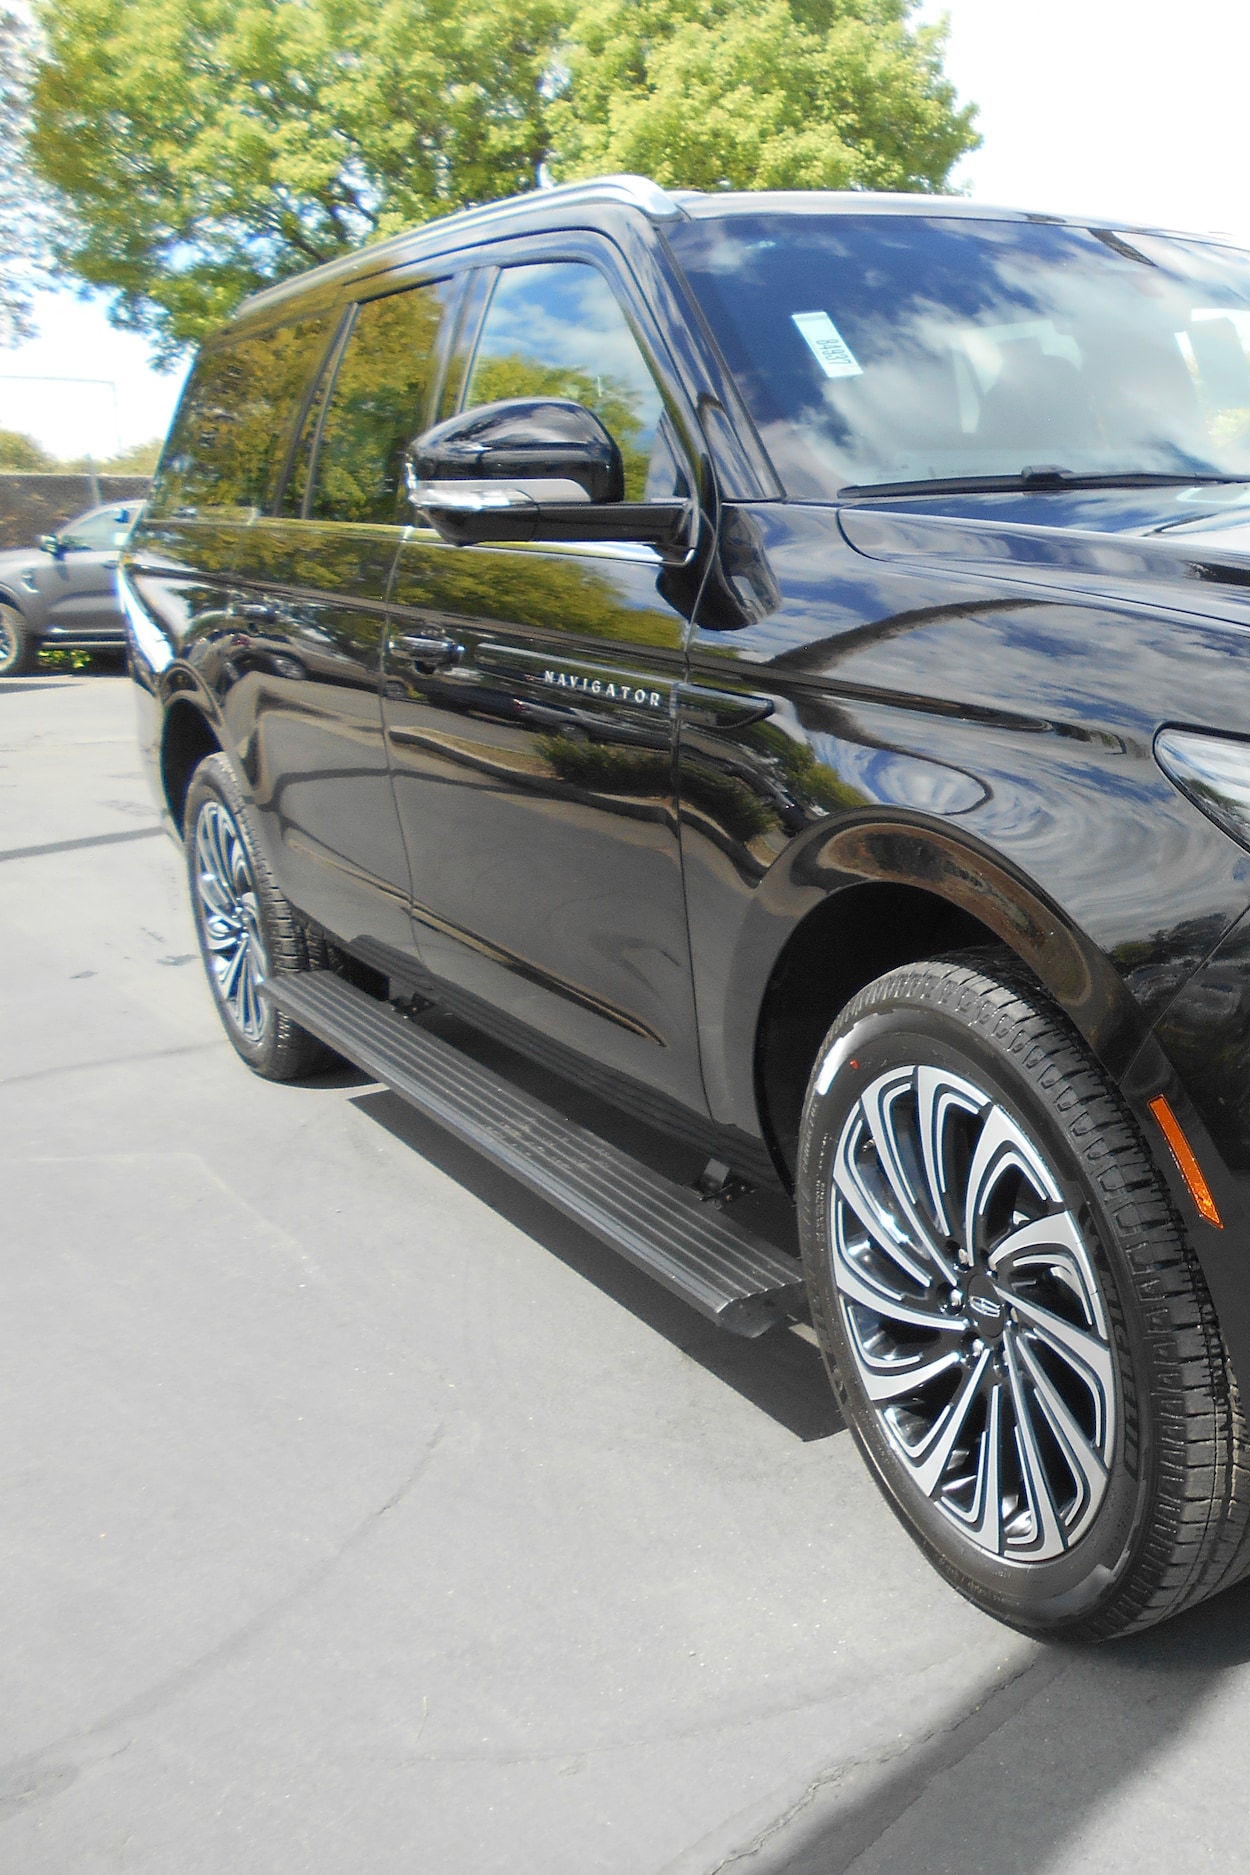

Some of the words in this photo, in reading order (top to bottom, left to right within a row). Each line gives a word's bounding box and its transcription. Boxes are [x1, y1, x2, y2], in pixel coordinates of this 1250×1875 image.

[815, 338, 852, 365] 84937
[543, 670, 660, 707] NAVIGATOR
[1097, 1267, 1138, 1472] MICHELIN
